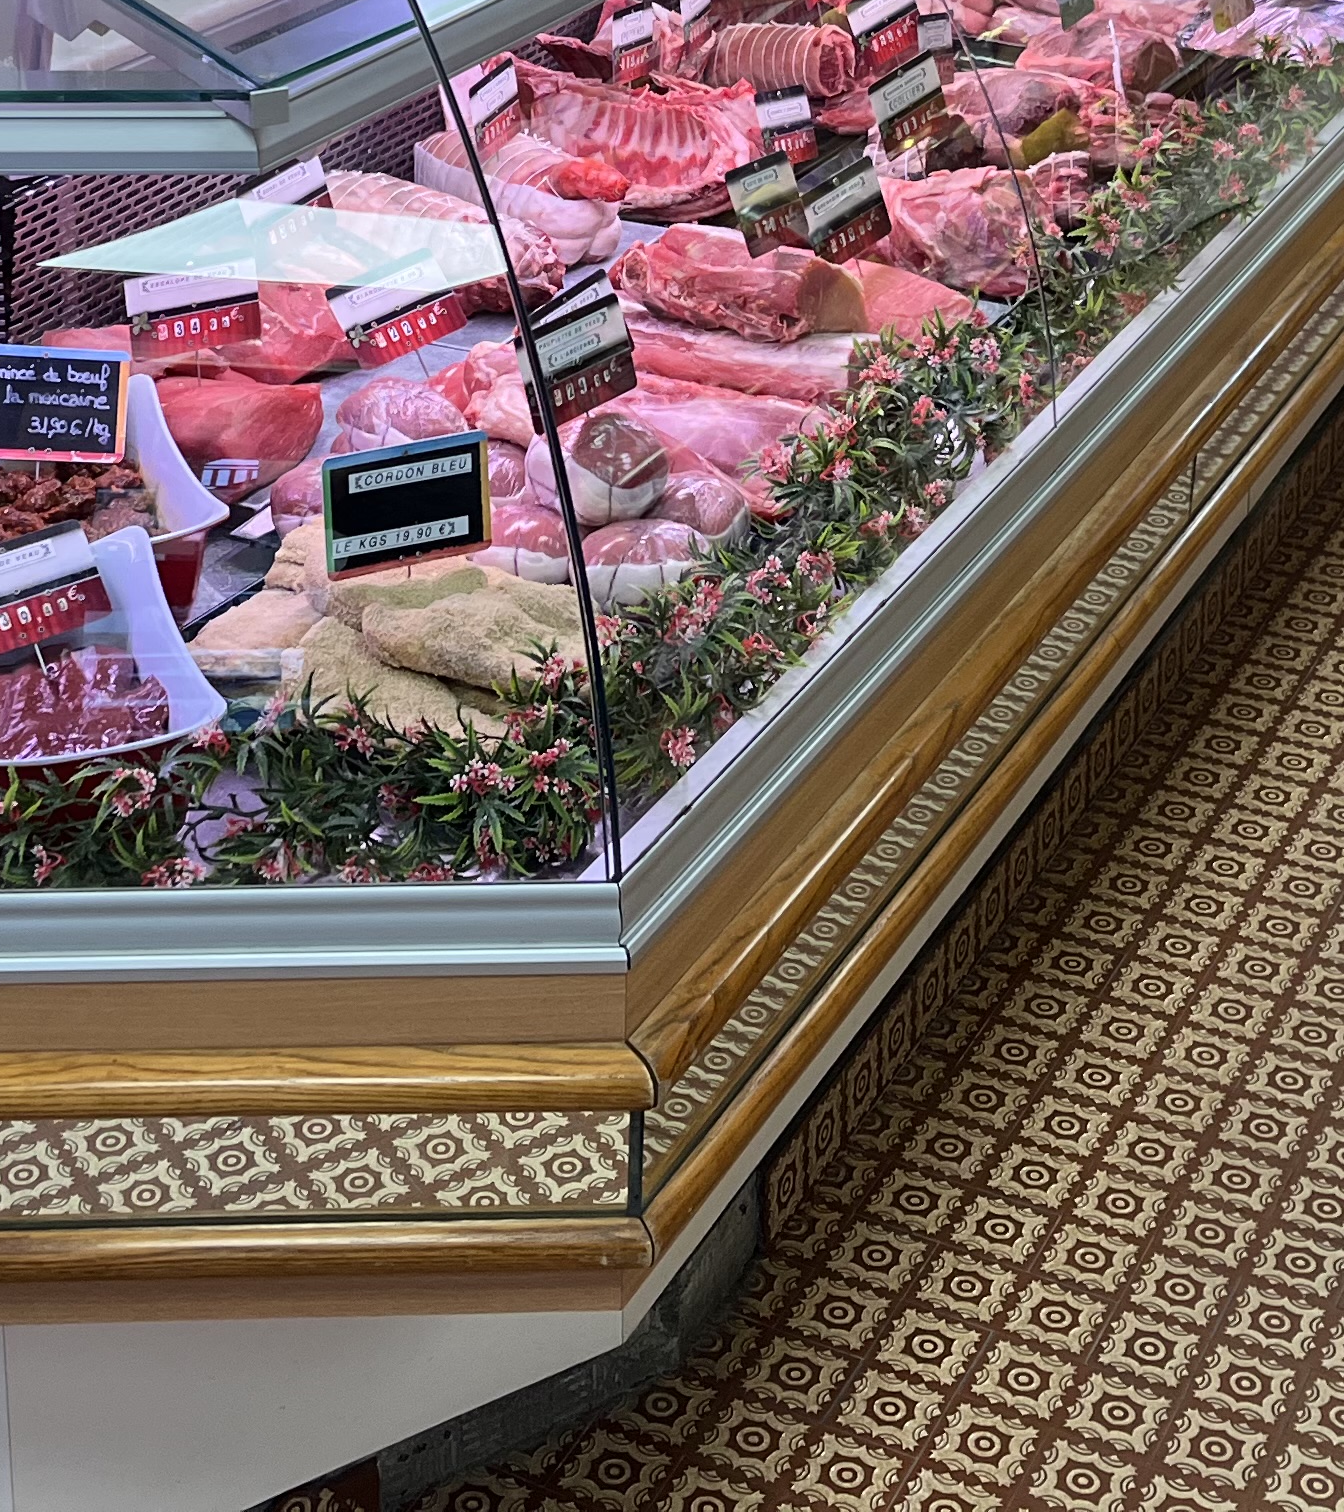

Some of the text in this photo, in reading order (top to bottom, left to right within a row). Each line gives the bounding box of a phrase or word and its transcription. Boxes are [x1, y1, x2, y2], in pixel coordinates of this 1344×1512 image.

[42, 366, 62, 383] de
[3, 384, 24, 404] la
[28, 388, 110, 410] mexicaine
[364, 458, 468, 487] CORDON BLEU
[335, 541, 352, 554] LE
[359, 535, 387, 550] KGS
[396, 526, 432, 543] 19,90
[0, 559, 10, 567] DE
[16, 550, 40, 562] VEAU
